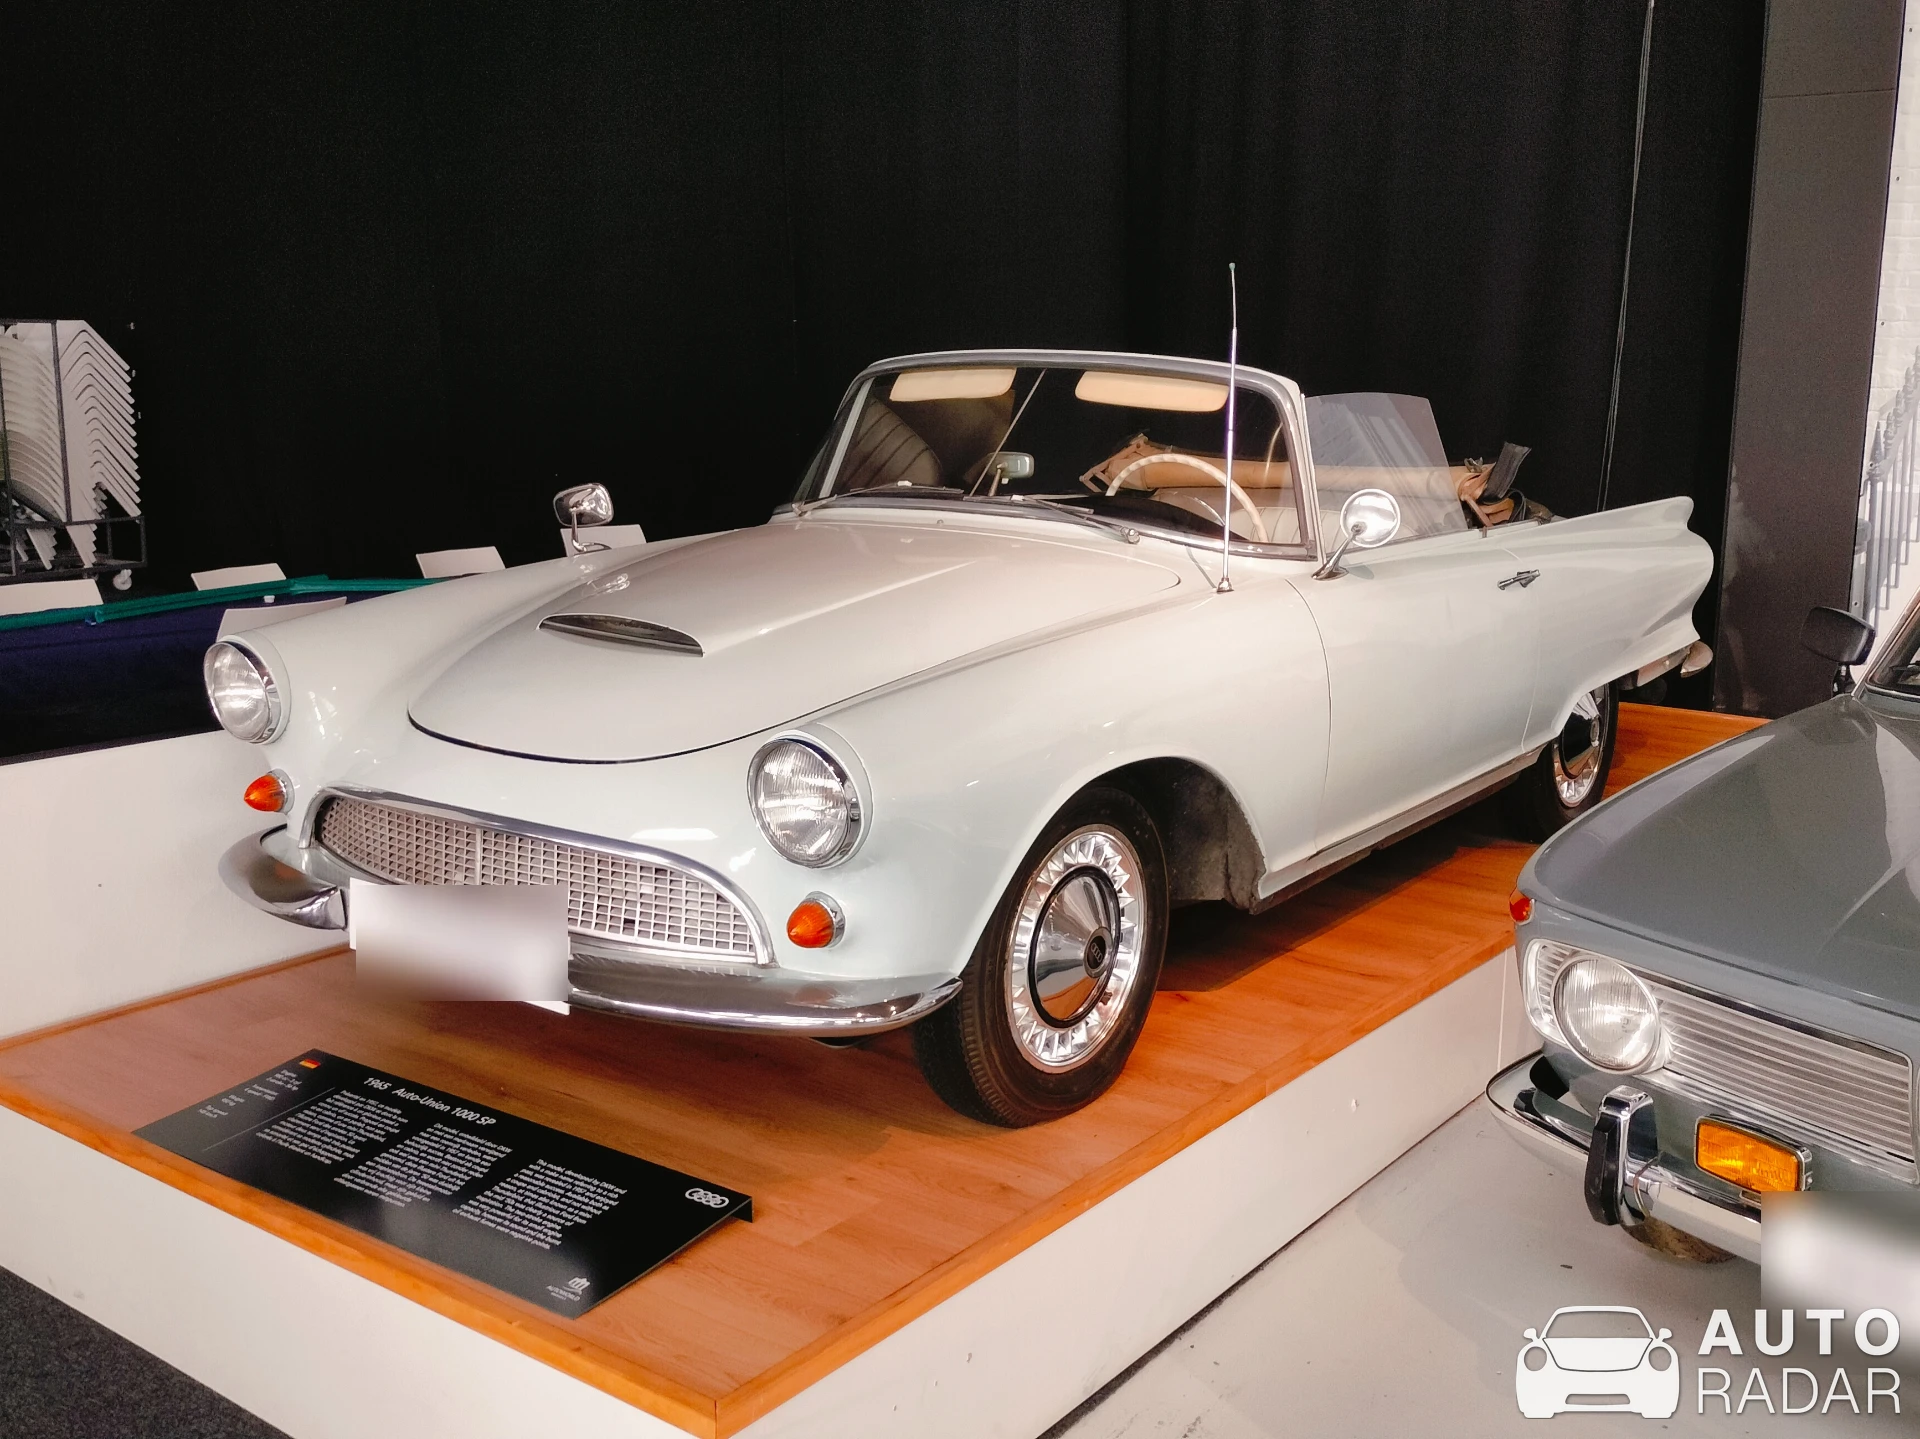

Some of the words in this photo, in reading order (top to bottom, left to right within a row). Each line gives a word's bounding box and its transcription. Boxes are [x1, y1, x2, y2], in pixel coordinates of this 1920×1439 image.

[363, 1077, 393, 1090] 1965
[391, 1087, 451, 1112] Auto-Union
[450, 1107, 481, 1121] 1000
[475, 1116, 497, 1126] SP
